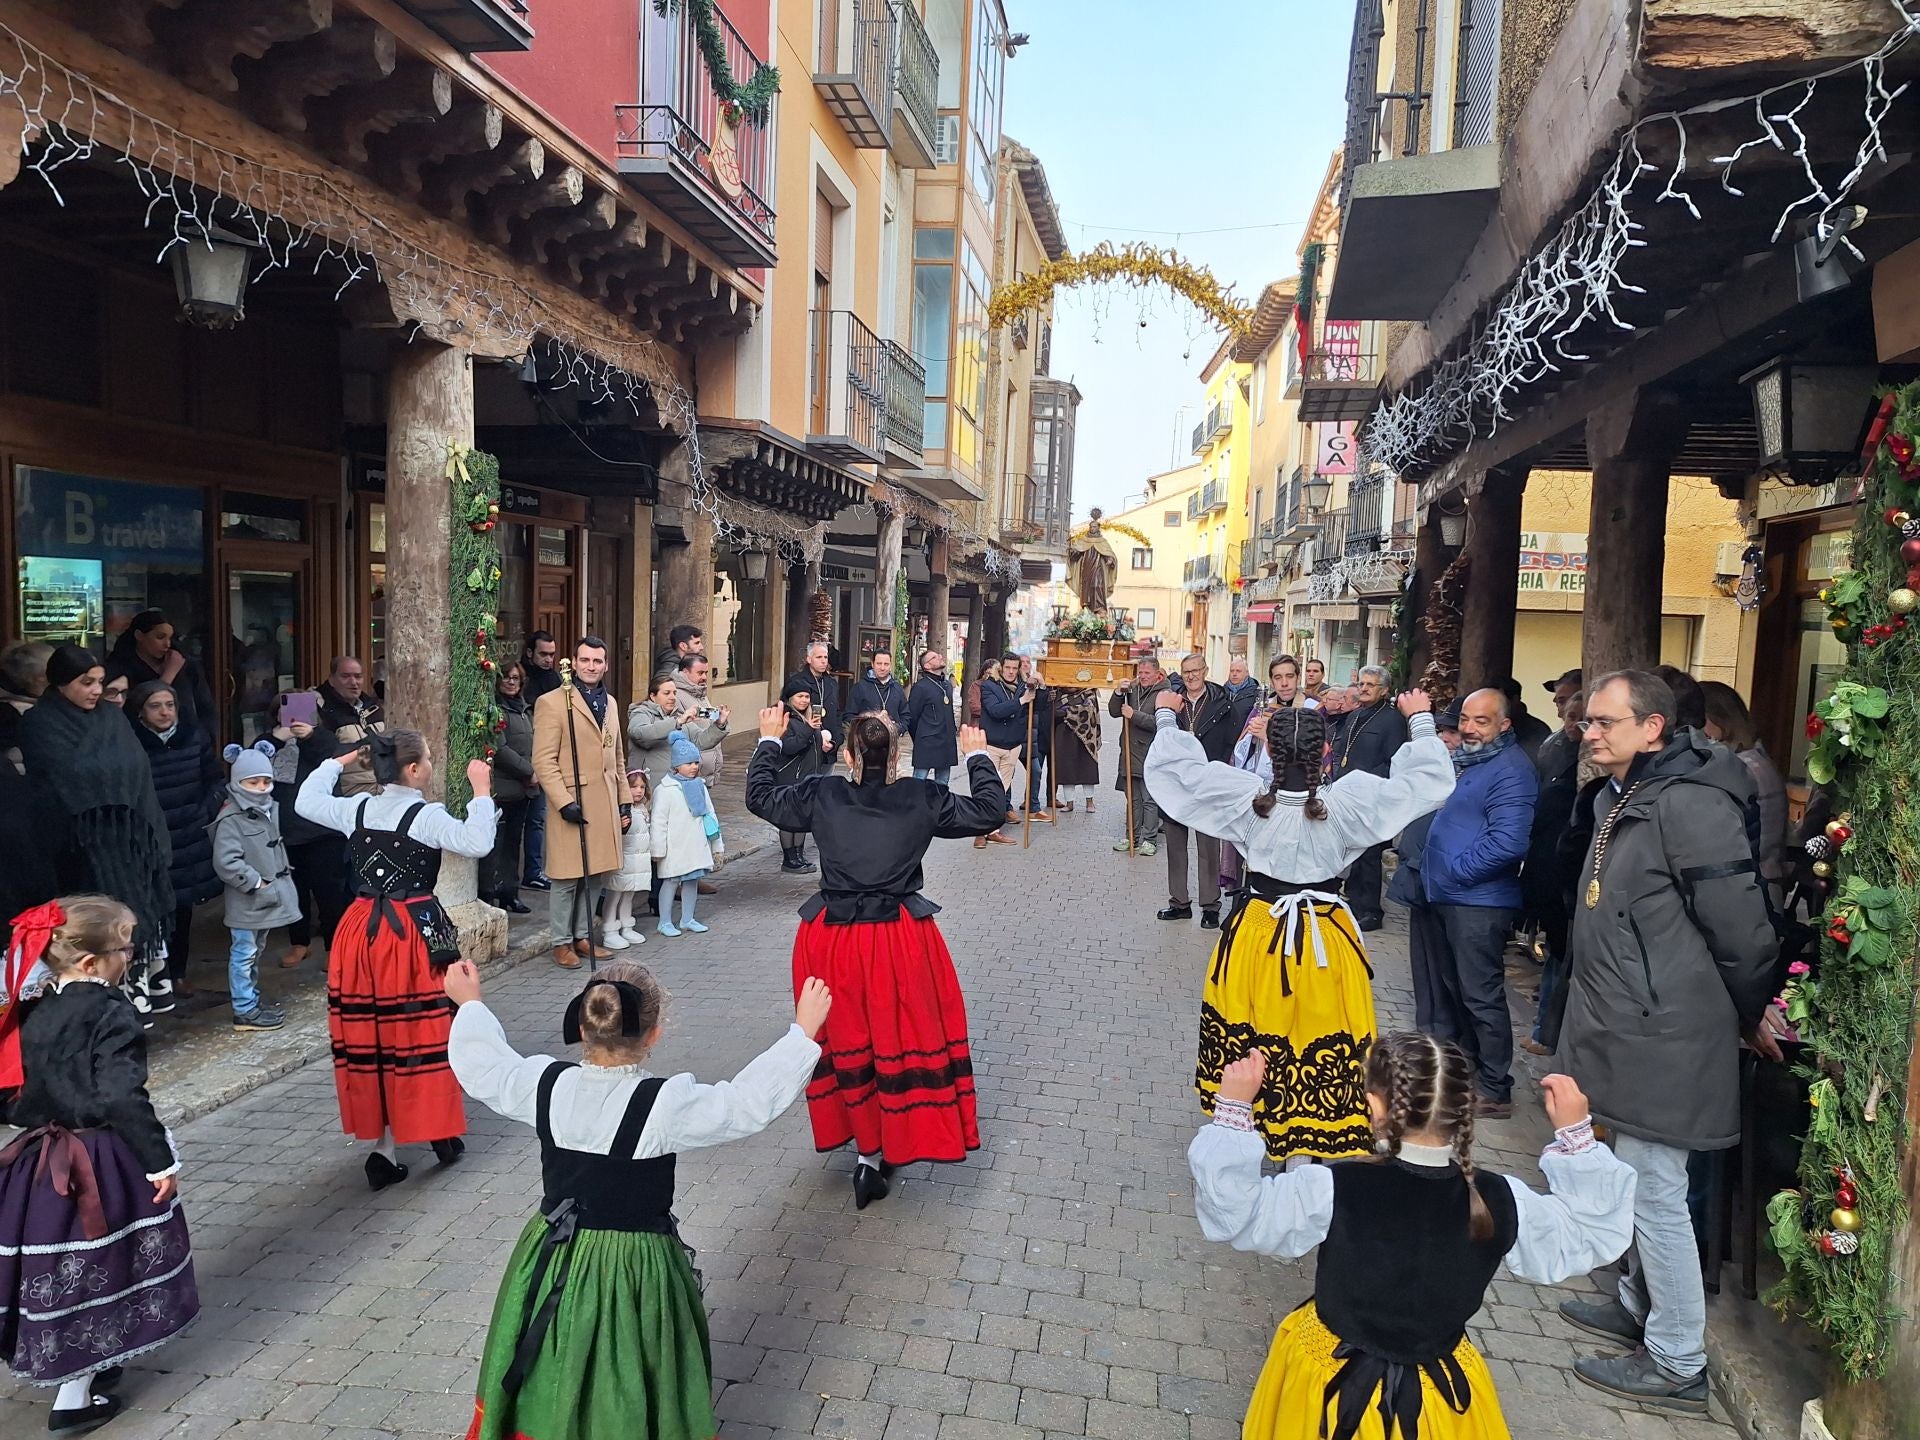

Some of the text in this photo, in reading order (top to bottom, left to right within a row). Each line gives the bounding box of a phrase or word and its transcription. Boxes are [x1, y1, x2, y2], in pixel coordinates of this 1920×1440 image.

[1326, 325, 1360, 341] PAN
[1326, 421, 1348, 466] IGA
[65, 490, 165, 549] B travel
[1518, 572, 1543, 590] RIA
